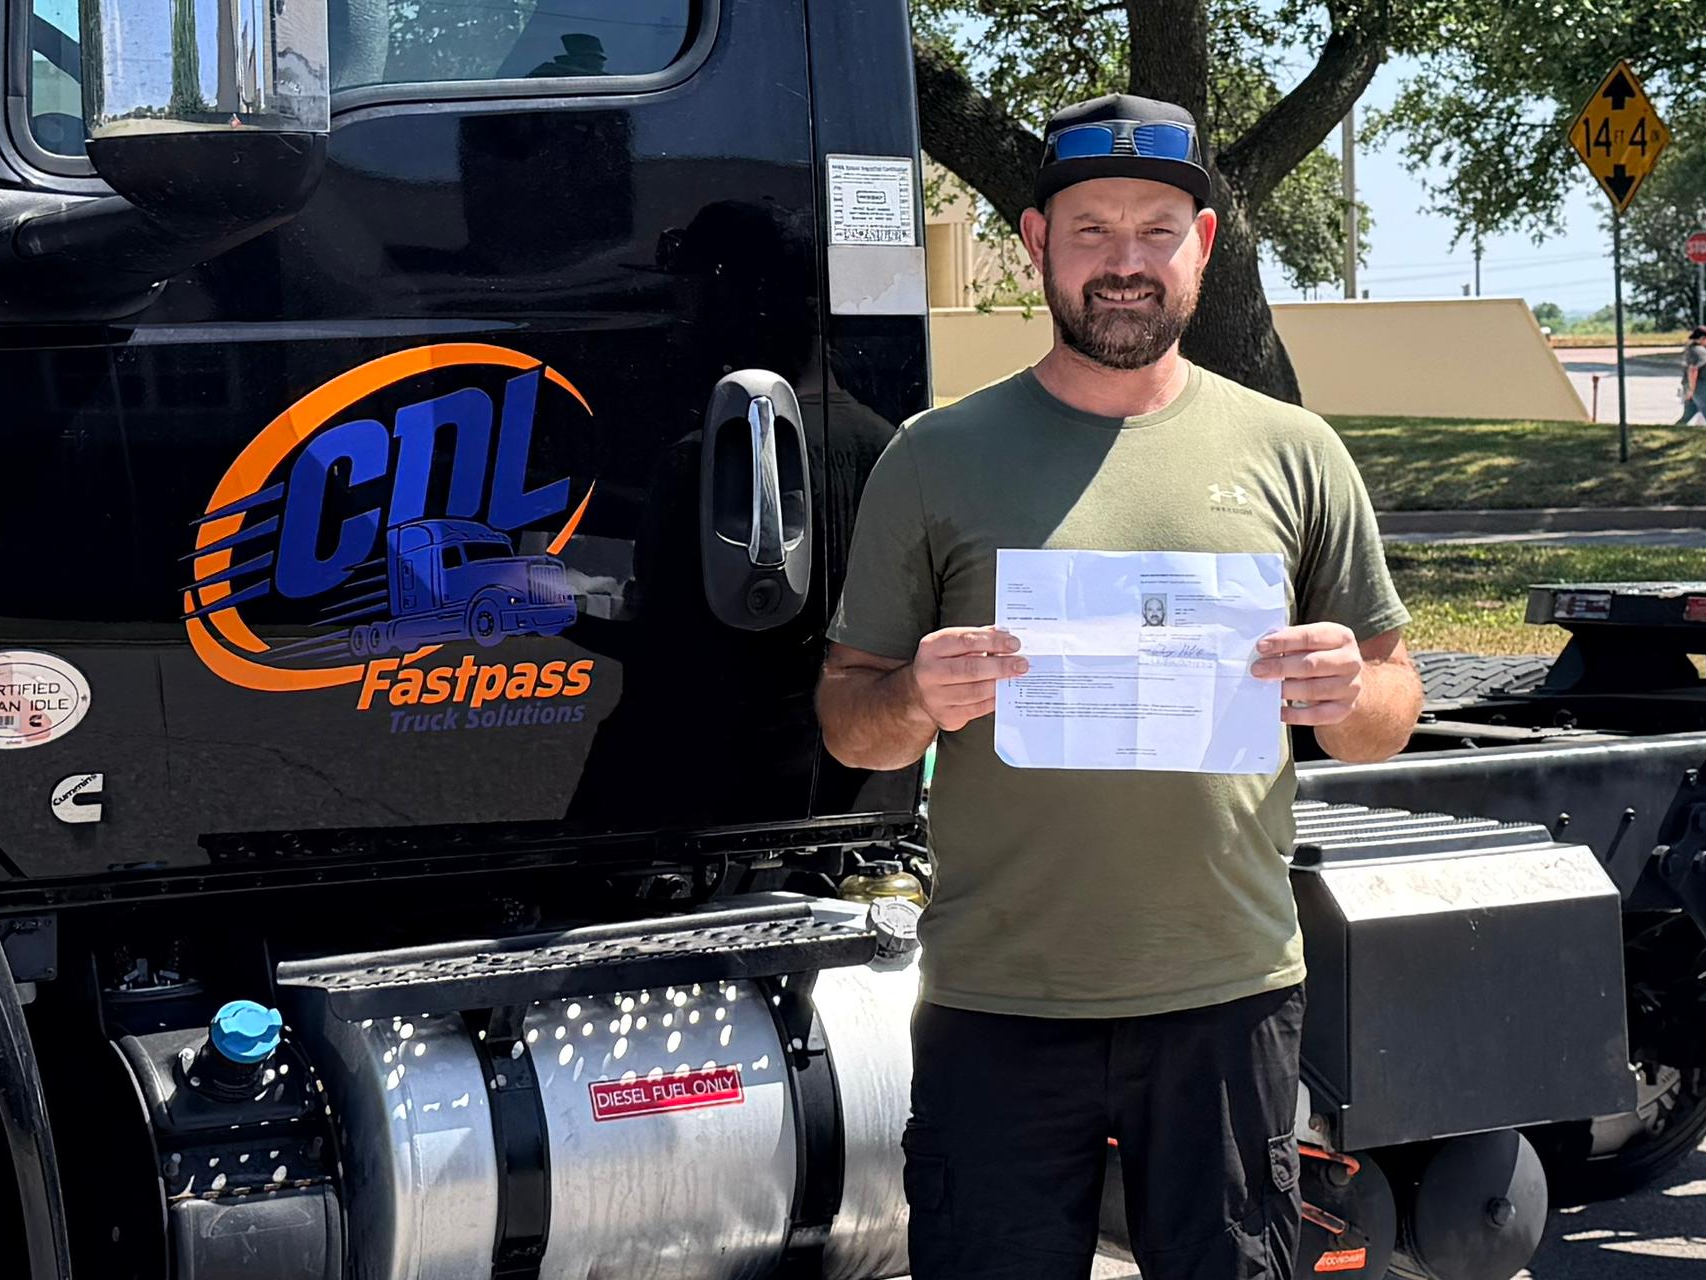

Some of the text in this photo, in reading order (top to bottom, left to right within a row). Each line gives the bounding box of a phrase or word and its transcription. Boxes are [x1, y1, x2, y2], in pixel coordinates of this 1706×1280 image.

[1583, 117, 1612, 157] 14
[1629, 117, 1647, 157] 4
[357, 655, 595, 710] Fastpass
[30, 698, 69, 712] IDLE
[389, 701, 586, 733] Truck Solutions
[52, 774, 97, 807] Cummins
[596, 1076, 735, 1108] DIESEL FUEL ONLY
